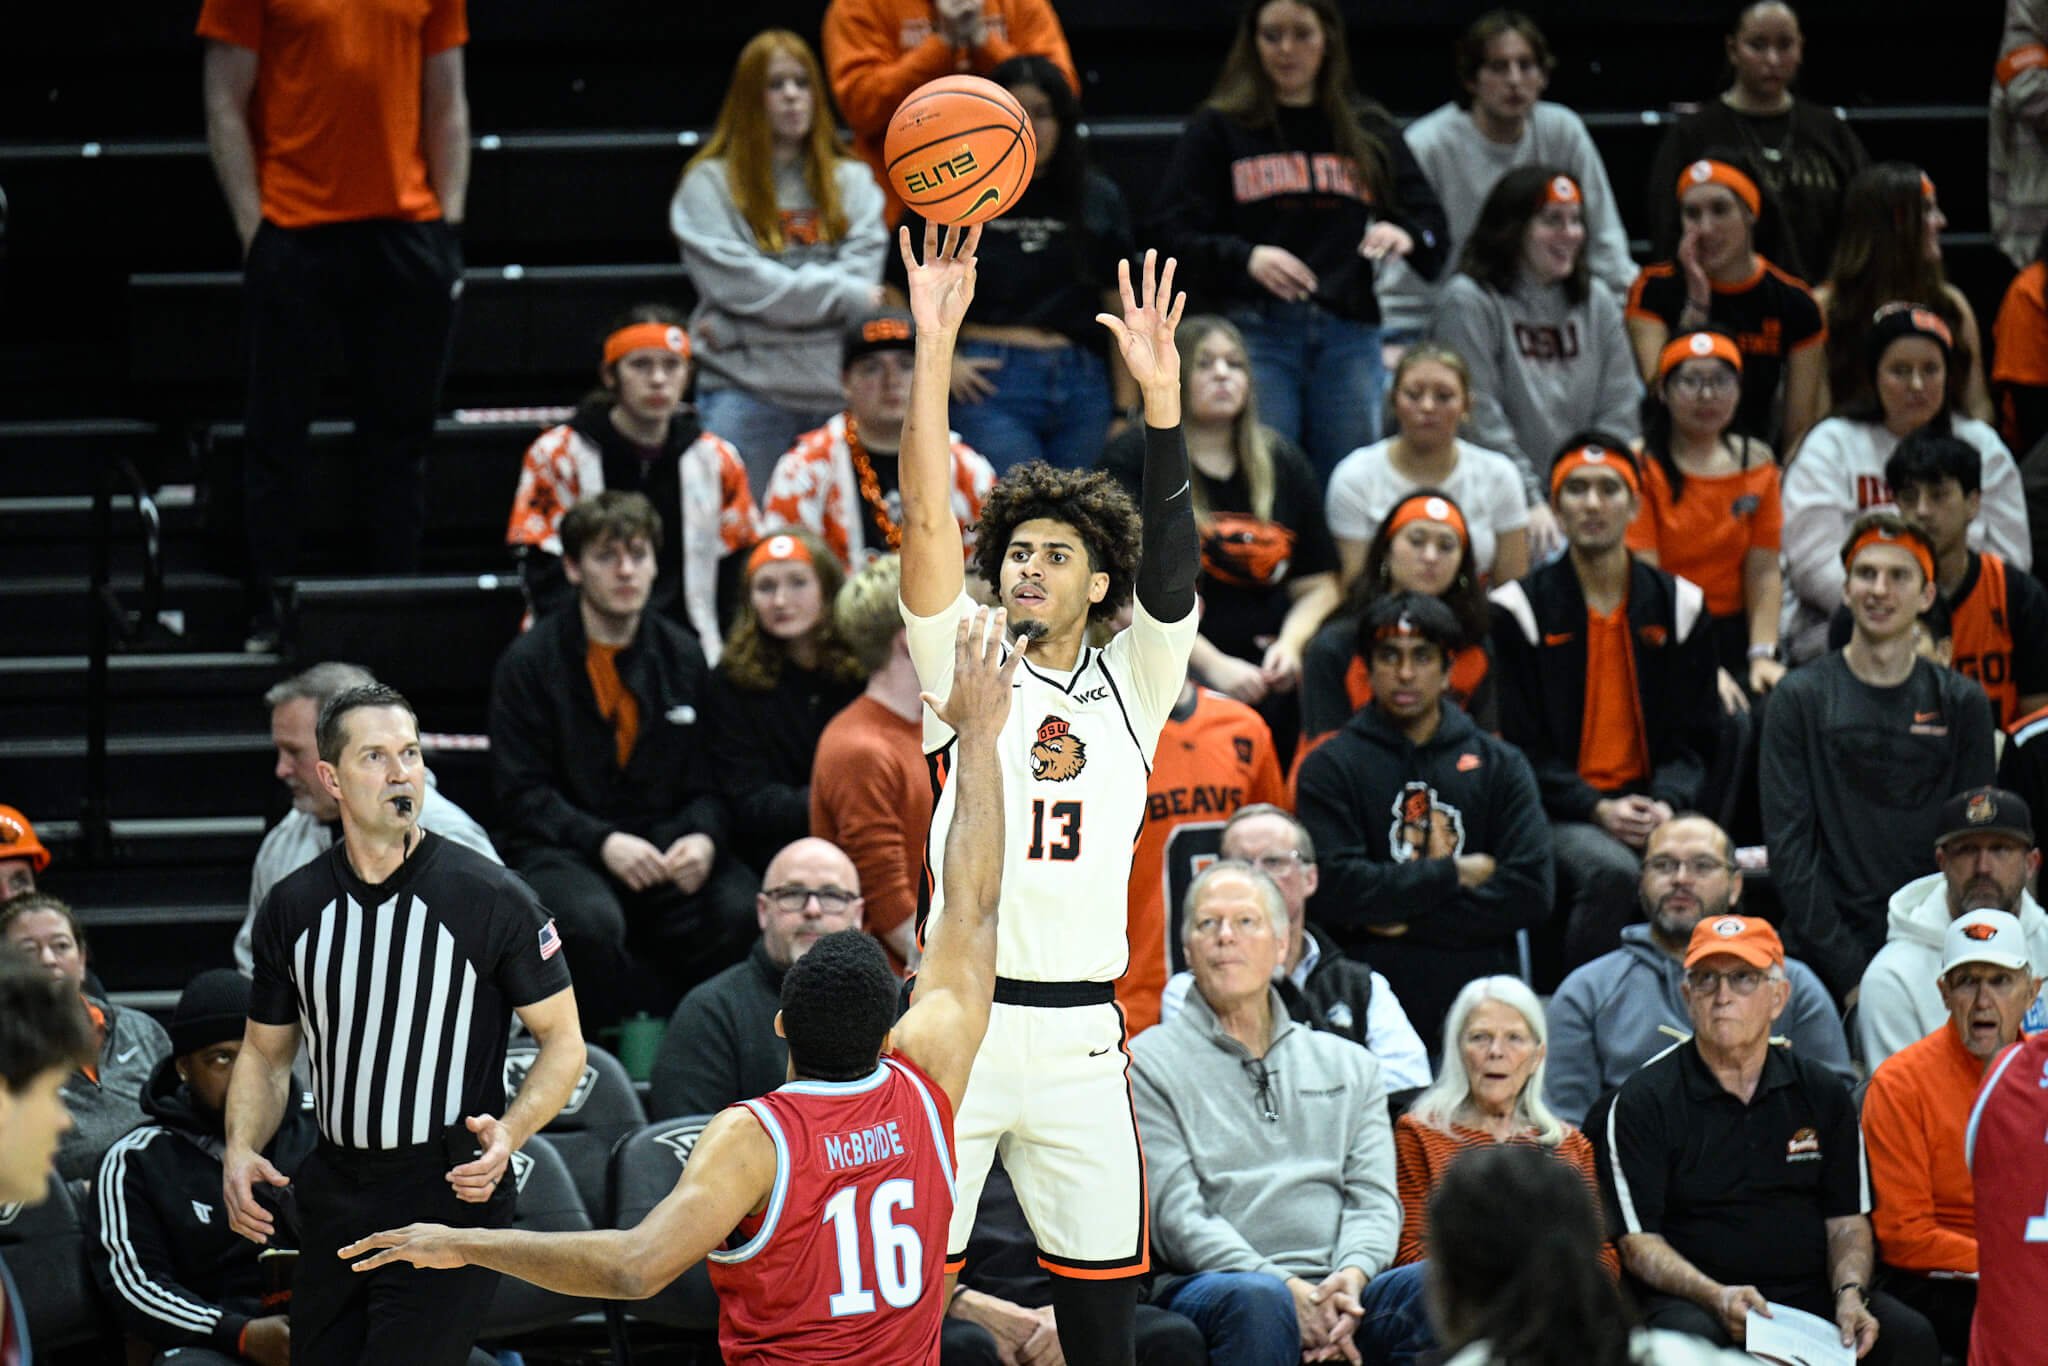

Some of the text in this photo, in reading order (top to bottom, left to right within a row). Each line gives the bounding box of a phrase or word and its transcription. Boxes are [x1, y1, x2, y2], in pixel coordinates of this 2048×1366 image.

[1072, 686, 1109, 705] WCC
[1039, 723, 1067, 740] OSU
[1149, 784, 1244, 822] BEAVS
[1027, 798, 1083, 862] 13
[824, 1121, 905, 1171] McBRIDE
[821, 1177, 923, 1318] 16
